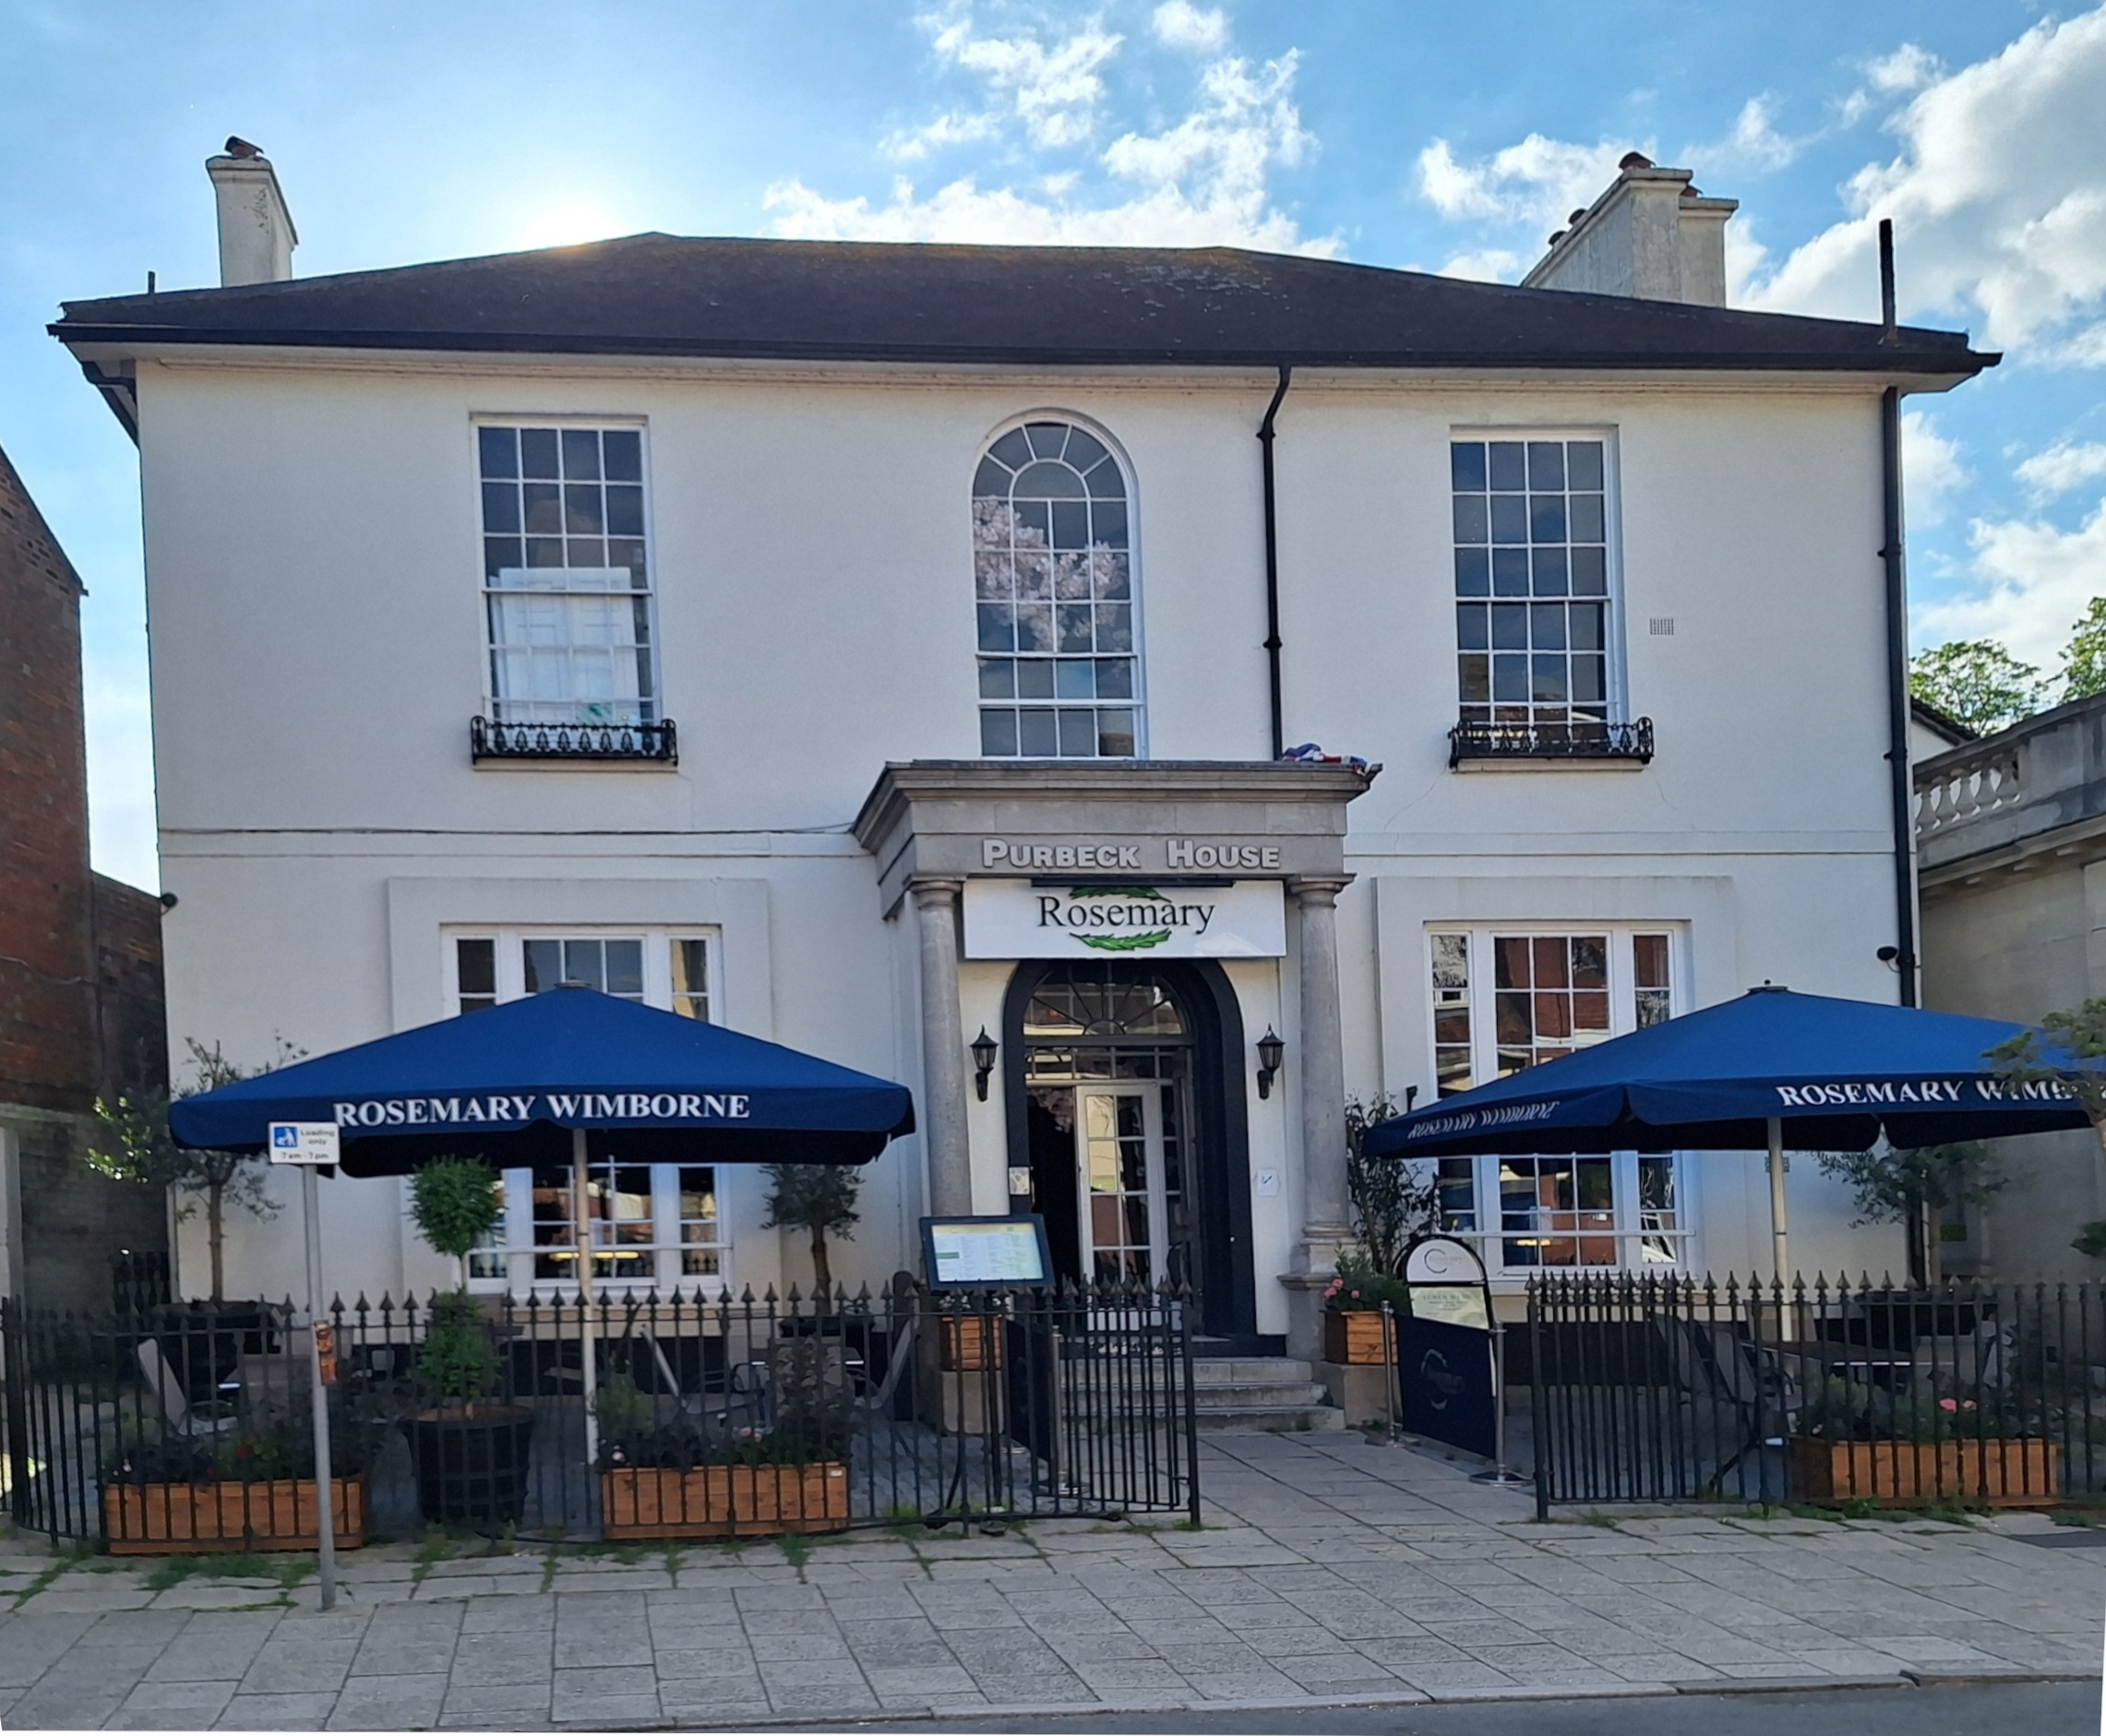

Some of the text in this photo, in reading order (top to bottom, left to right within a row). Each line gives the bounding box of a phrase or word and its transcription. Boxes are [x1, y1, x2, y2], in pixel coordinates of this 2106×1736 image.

[982, 839, 1280, 868] PURBECK HOUSE
[1036, 895, 1215, 935] Rosemary
[1776, 1080, 1964, 1107] ROSEMARY
[333, 1094, 751, 1127] ROSEMARY WIMBORNE
[300, 1128, 335, 1137] Loading
[307, 1137, 327, 1146] only
